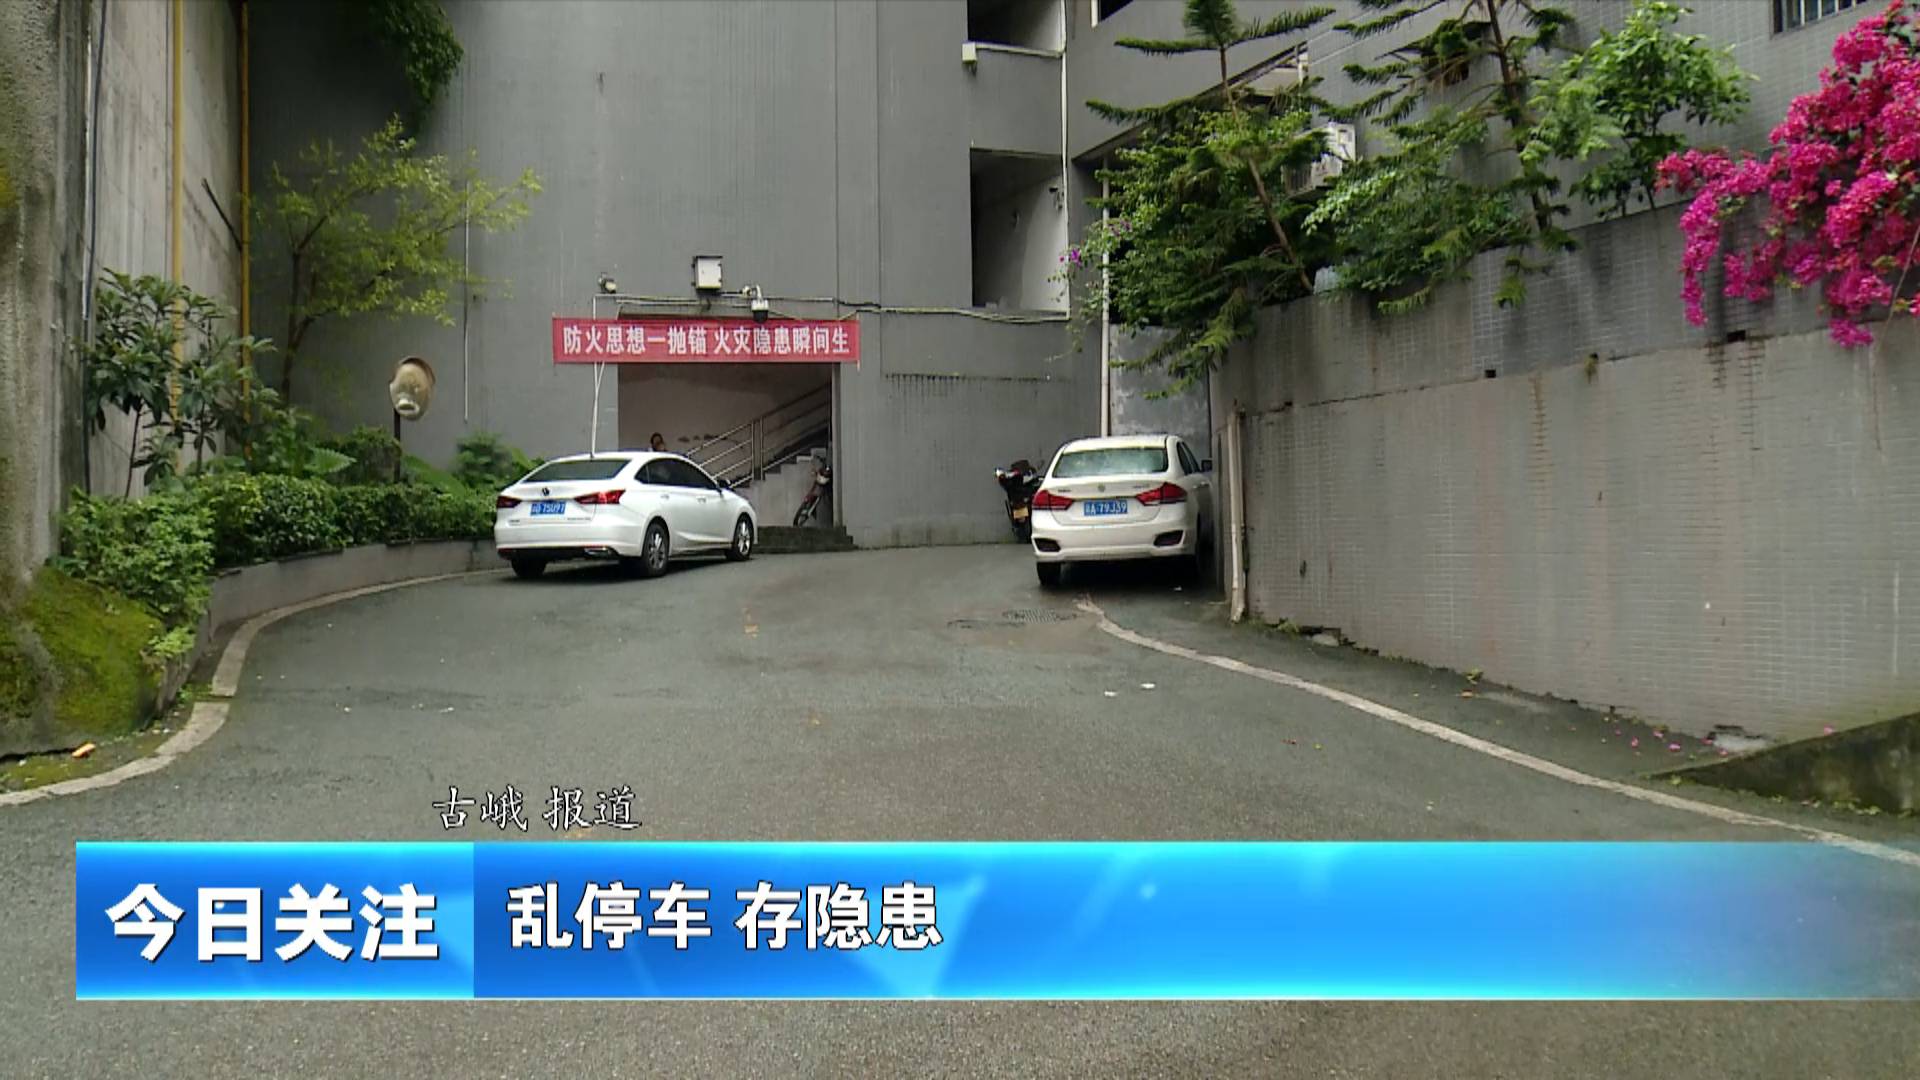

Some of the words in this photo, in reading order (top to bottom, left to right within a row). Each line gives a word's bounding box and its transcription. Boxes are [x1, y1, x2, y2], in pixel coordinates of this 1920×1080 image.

[563, 326, 708, 355] 防火思想一抛锚
[714, 326, 850, 354] 火灾隐患瞬间生
